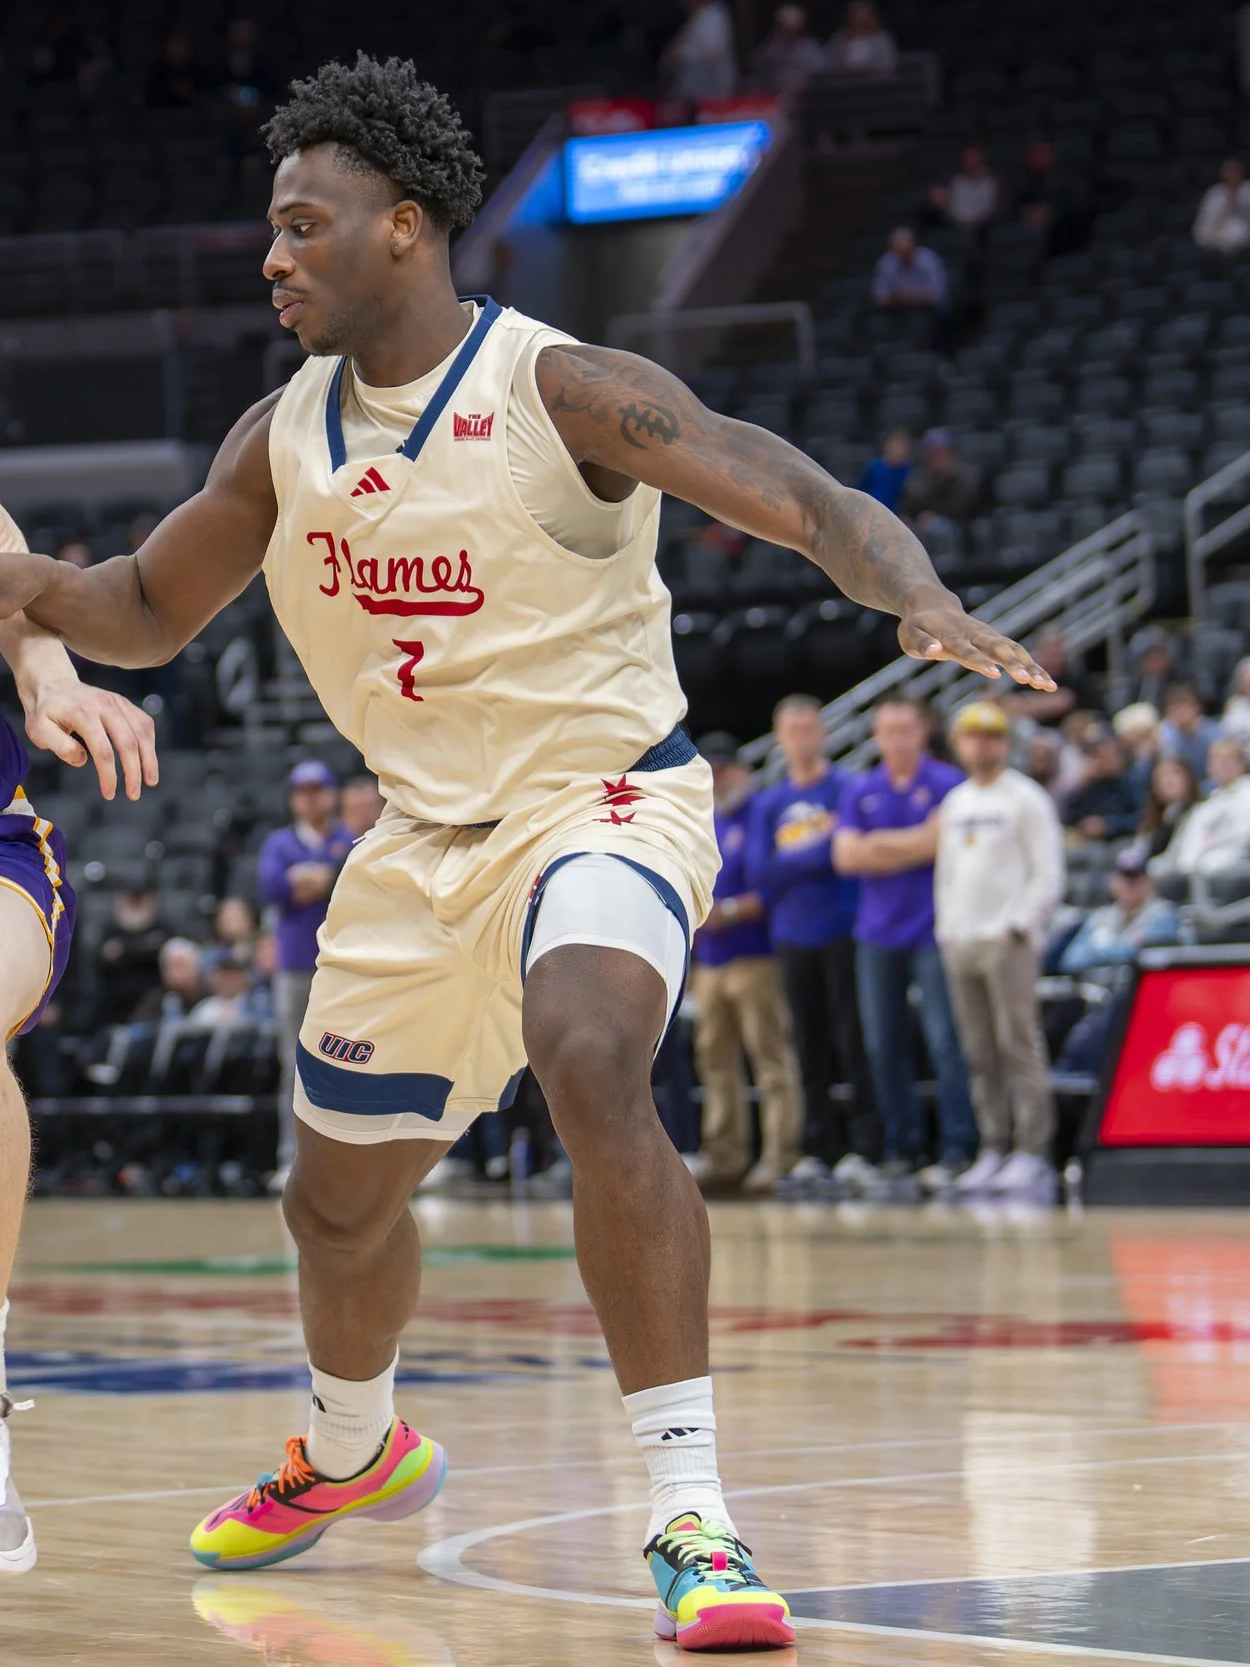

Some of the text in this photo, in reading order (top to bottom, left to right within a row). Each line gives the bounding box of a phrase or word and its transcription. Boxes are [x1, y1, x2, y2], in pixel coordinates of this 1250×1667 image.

[453, 411, 495, 437] VALLEY
[306, 531, 485, 600] Flames
[392, 638, 425, 702] 7
[319, 1032, 375, 1064] UIC
